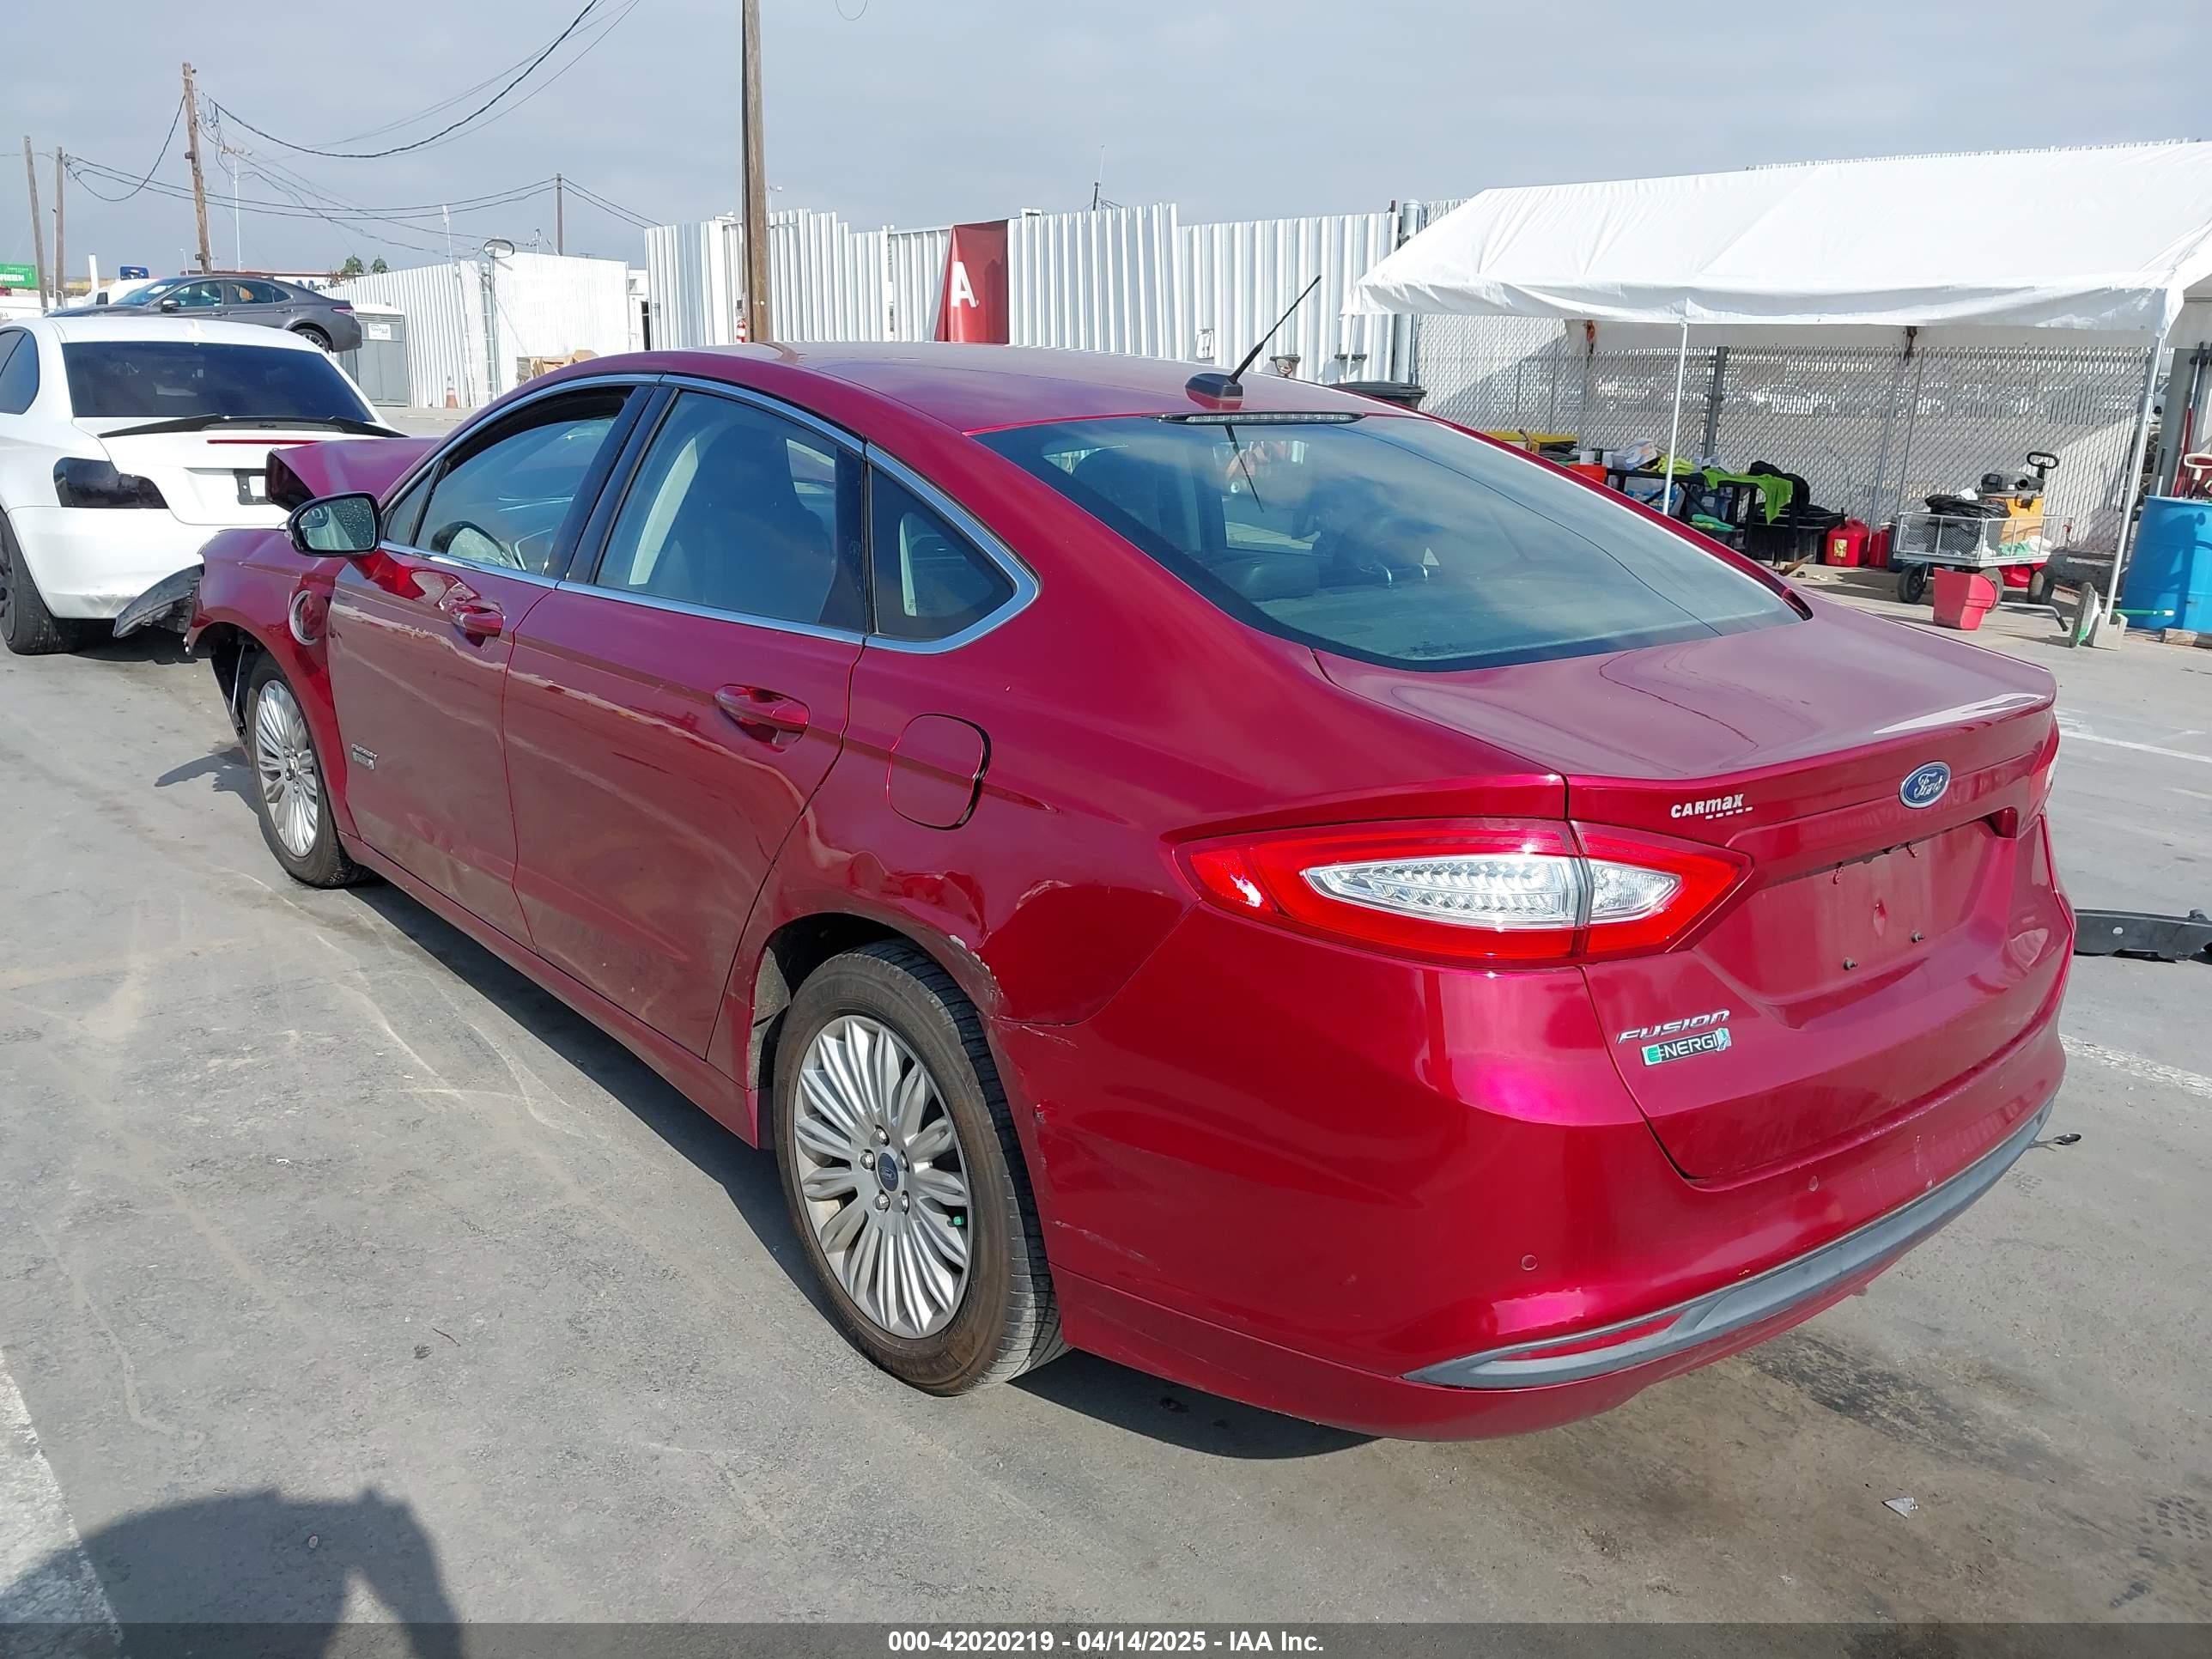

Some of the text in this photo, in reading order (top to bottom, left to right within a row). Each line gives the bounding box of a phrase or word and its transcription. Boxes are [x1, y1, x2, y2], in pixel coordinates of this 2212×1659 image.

[1914, 771, 1943, 799] Ford
[1616, 1009, 1730, 1044] FUSION
[1644, 1033, 1718, 1064] ENERGI
